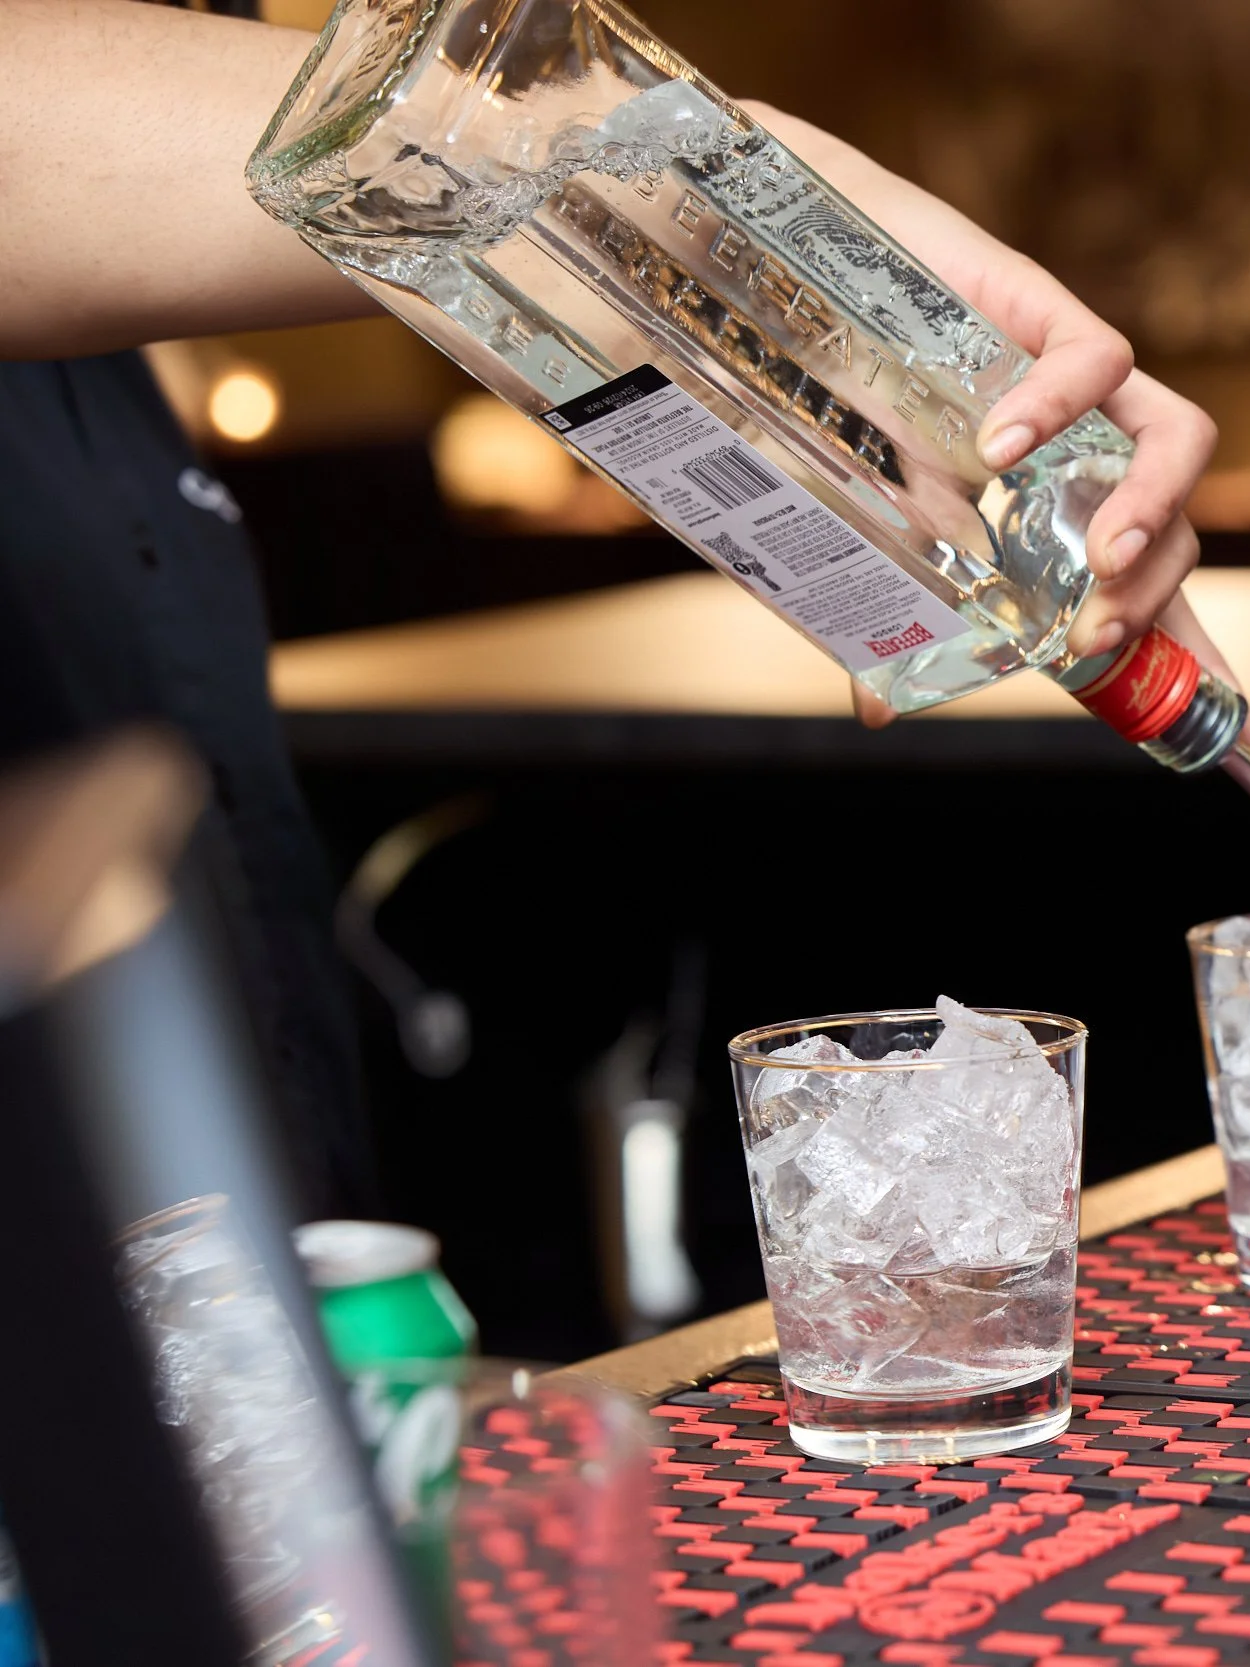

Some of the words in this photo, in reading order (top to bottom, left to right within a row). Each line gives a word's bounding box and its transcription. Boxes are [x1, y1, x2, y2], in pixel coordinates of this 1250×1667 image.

[632, 168, 967, 453] BEEFEATER
[680, 405, 694, 414] THE
[633, 412, 653, 425] LONDON
[656, 409, 684, 425] BEEFEATER
[673, 432, 688, 440] WITH
[688, 424, 704, 434] MADE
[688, 425, 720, 443] DISTILLED
[642, 445, 660, 455] GRAIN
[674, 440, 689, 449] AND
[648, 446, 676, 461] BOTTLED
[871, 624, 902, 639] LONDON
[864, 621, 935, 658] BEEFEATER
